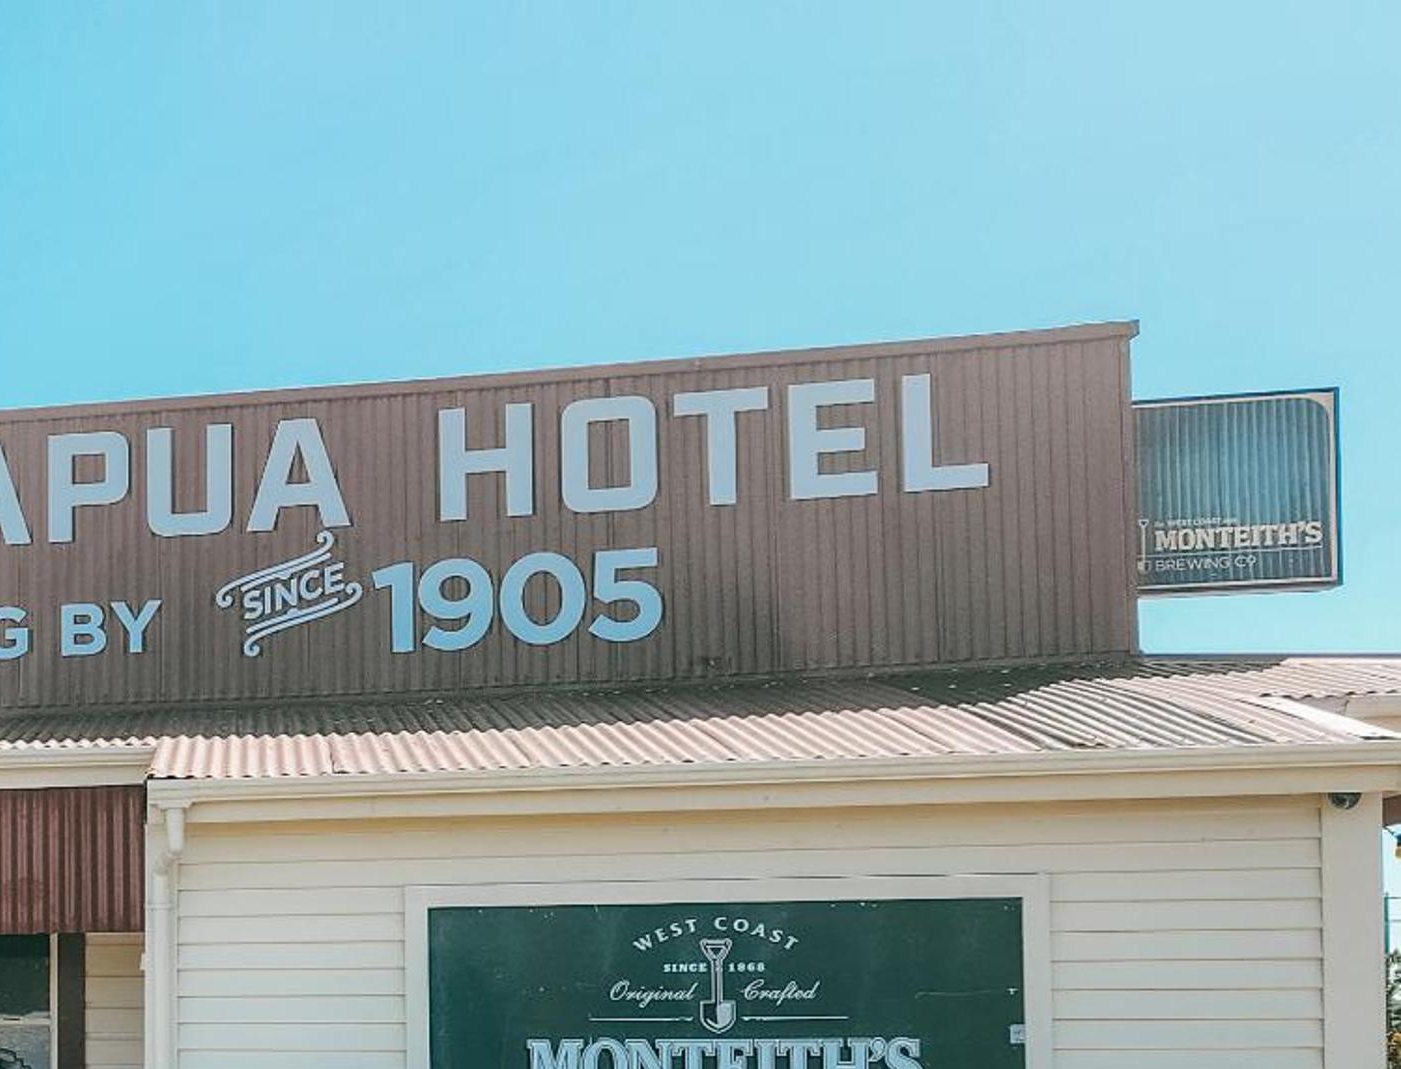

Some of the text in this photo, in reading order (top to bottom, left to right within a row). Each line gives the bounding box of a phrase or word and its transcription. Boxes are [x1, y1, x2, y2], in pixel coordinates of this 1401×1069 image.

[437, 372, 991, 522] HOTEL
[1154, 520, 1324, 552] MONTEITH'S
[1155, 555, 1231, 571] BREWING
[59, 600, 163, 658] BY
[243, 561, 345, 620] SINCE
[371, 546, 664, 654] 1905
[631, 916, 800, 953] WEST COAST
[663, 961, 766, 973] SINCE 1868
[609, 978, 822, 1008] Original Crafted
